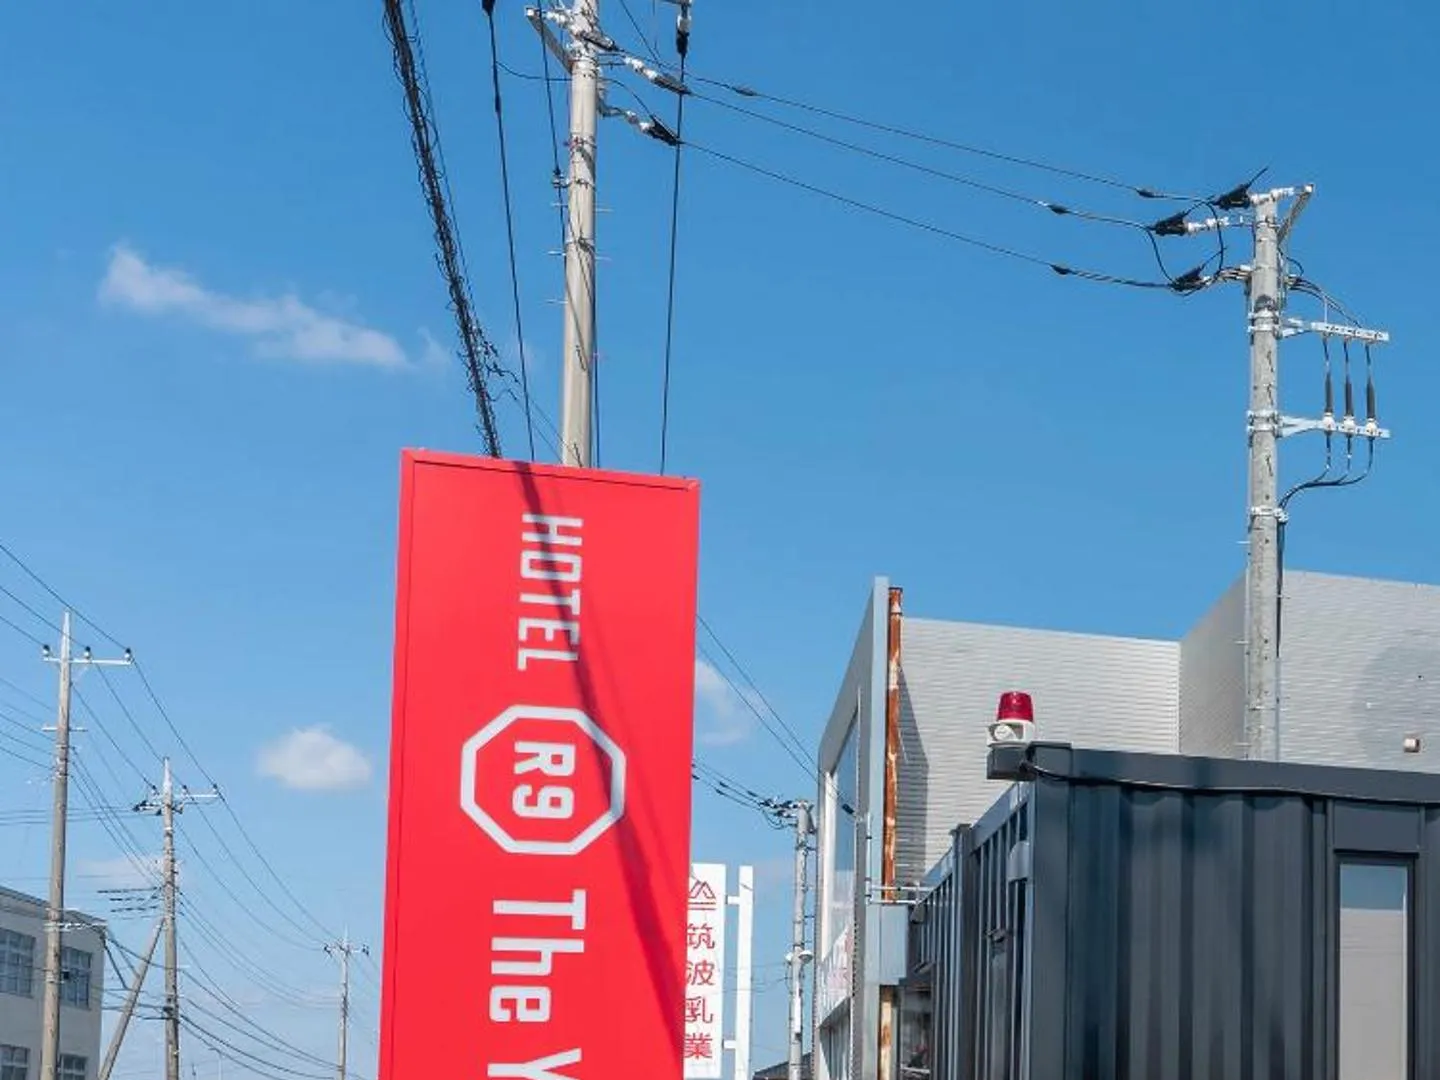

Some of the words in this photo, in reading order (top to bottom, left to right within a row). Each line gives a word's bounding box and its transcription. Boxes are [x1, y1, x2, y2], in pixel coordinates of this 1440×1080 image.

[517, 512, 583, 671] HOTEL
[512, 741, 576, 819] R9
[489, 889, 586, 1022] The
[685, 923, 716, 1060] 筑波乳業
